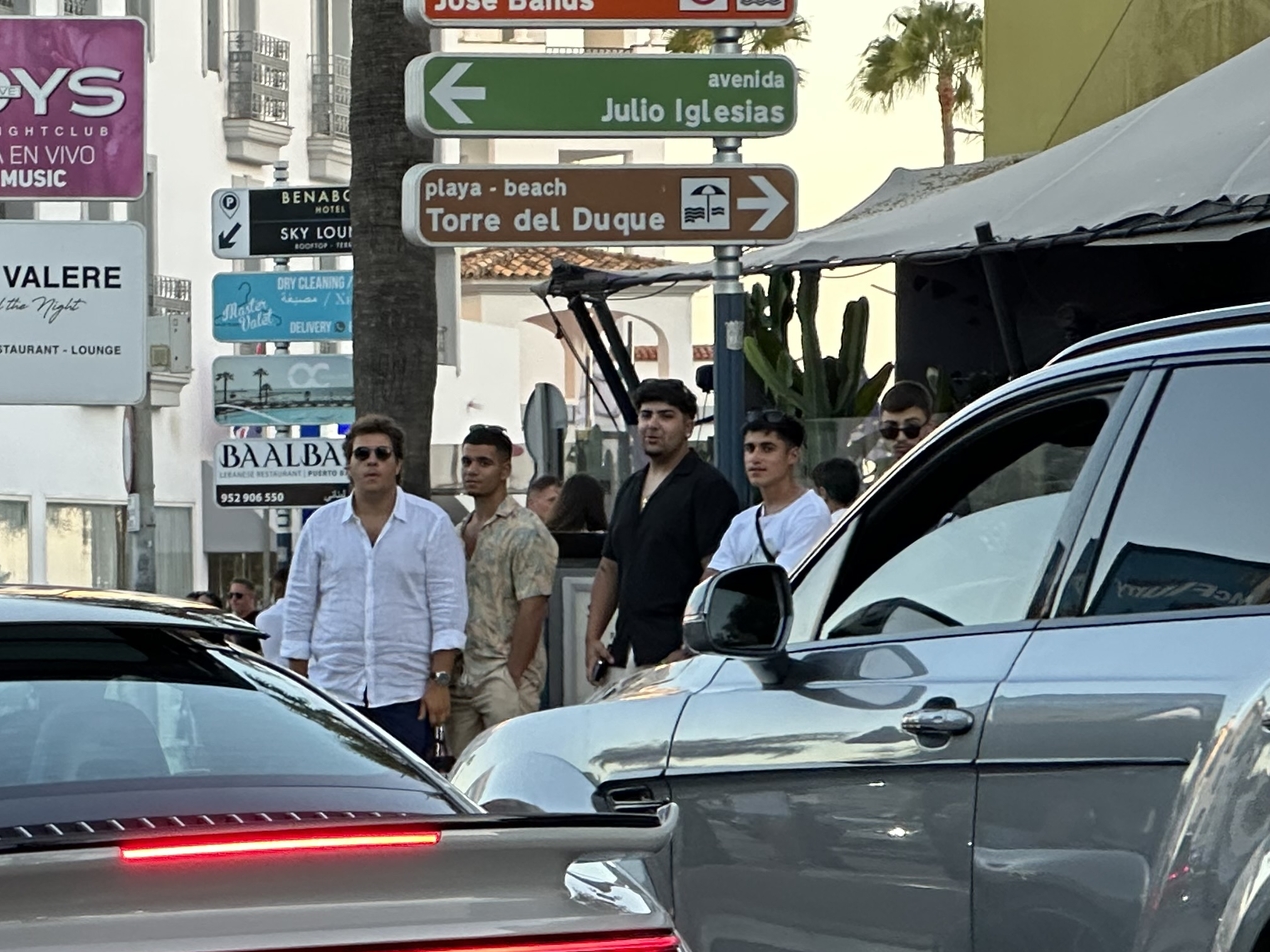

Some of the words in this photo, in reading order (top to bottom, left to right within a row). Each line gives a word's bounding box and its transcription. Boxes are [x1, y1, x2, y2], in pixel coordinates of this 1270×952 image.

[708, 70, 785, 89] avenida
[601, 98, 665, 123] Julio
[675, 98, 785, 128] Iglesias
[10, 146, 39, 165] EN
[45, 146, 95, 165] VIVO
[0, 169, 67, 188] MUSIC
[425, 178, 482, 200] playa
[504, 178, 567, 196] beach
[315, 206, 345, 214] HOTEL
[425, 207, 500, 232] Torre
[514, 207, 560, 232] del
[573, 206, 665, 236] Duque
[281, 227, 309, 240] SKY
[3, 265, 121, 289] VALERE
[277, 277, 296, 290] DRY
[298, 276, 345, 290] CLEANING
[5, 297, 29, 311] the
[32, 296, 87, 324] Night
[222, 298, 268, 321] Master
[238, 309, 273, 331] Valet
[290, 321, 332, 333] DELIVERY
[71, 345, 121, 355] LOUNGE
[256, 470, 301, 478] RESTAURANT
[221, 493, 241, 503] 952
[243, 493, 262, 502] 906
[264, 492, 284, 502] 550
